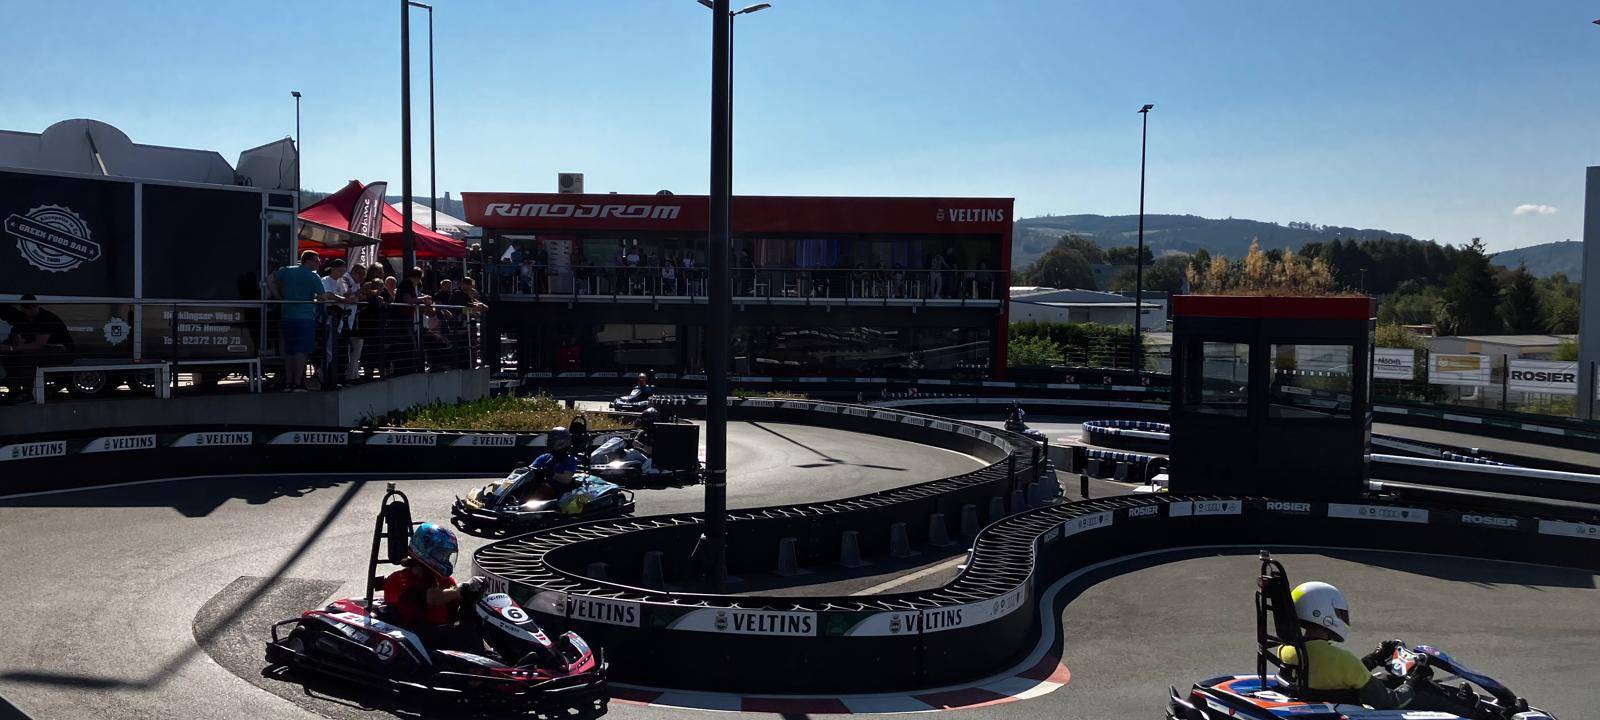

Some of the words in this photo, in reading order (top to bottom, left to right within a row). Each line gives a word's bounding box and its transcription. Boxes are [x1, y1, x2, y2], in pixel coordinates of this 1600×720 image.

[949, 208, 1004, 222] VELTINS
[19, 223, 46, 239] GREEK
[48, 234, 69, 246] FOOD
[70, 241, 88, 254] BAR
[235, 312, 240, 320] 3
[1511, 370, 1575, 383] ROSIER
[112, 436, 154, 449] VELTINS
[206, 433, 250, 445] VELTINS
[302, 432, 346, 444] VELTINS
[394, 434, 435, 445] VELTINS
[479, 436, 515, 446] VELTINS
[21, 443, 64, 457] VELTINS
[1128, 505, 1160, 518] ROSIER
[1266, 501, 1312, 512] ROSIER
[1461, 514, 1519, 528] ROSIER
[507, 608, 523, 619] 6
[568, 599, 635, 623] VELTINS
[733, 612, 812, 633] VELTINS
[377, 643, 392, 656] 12
